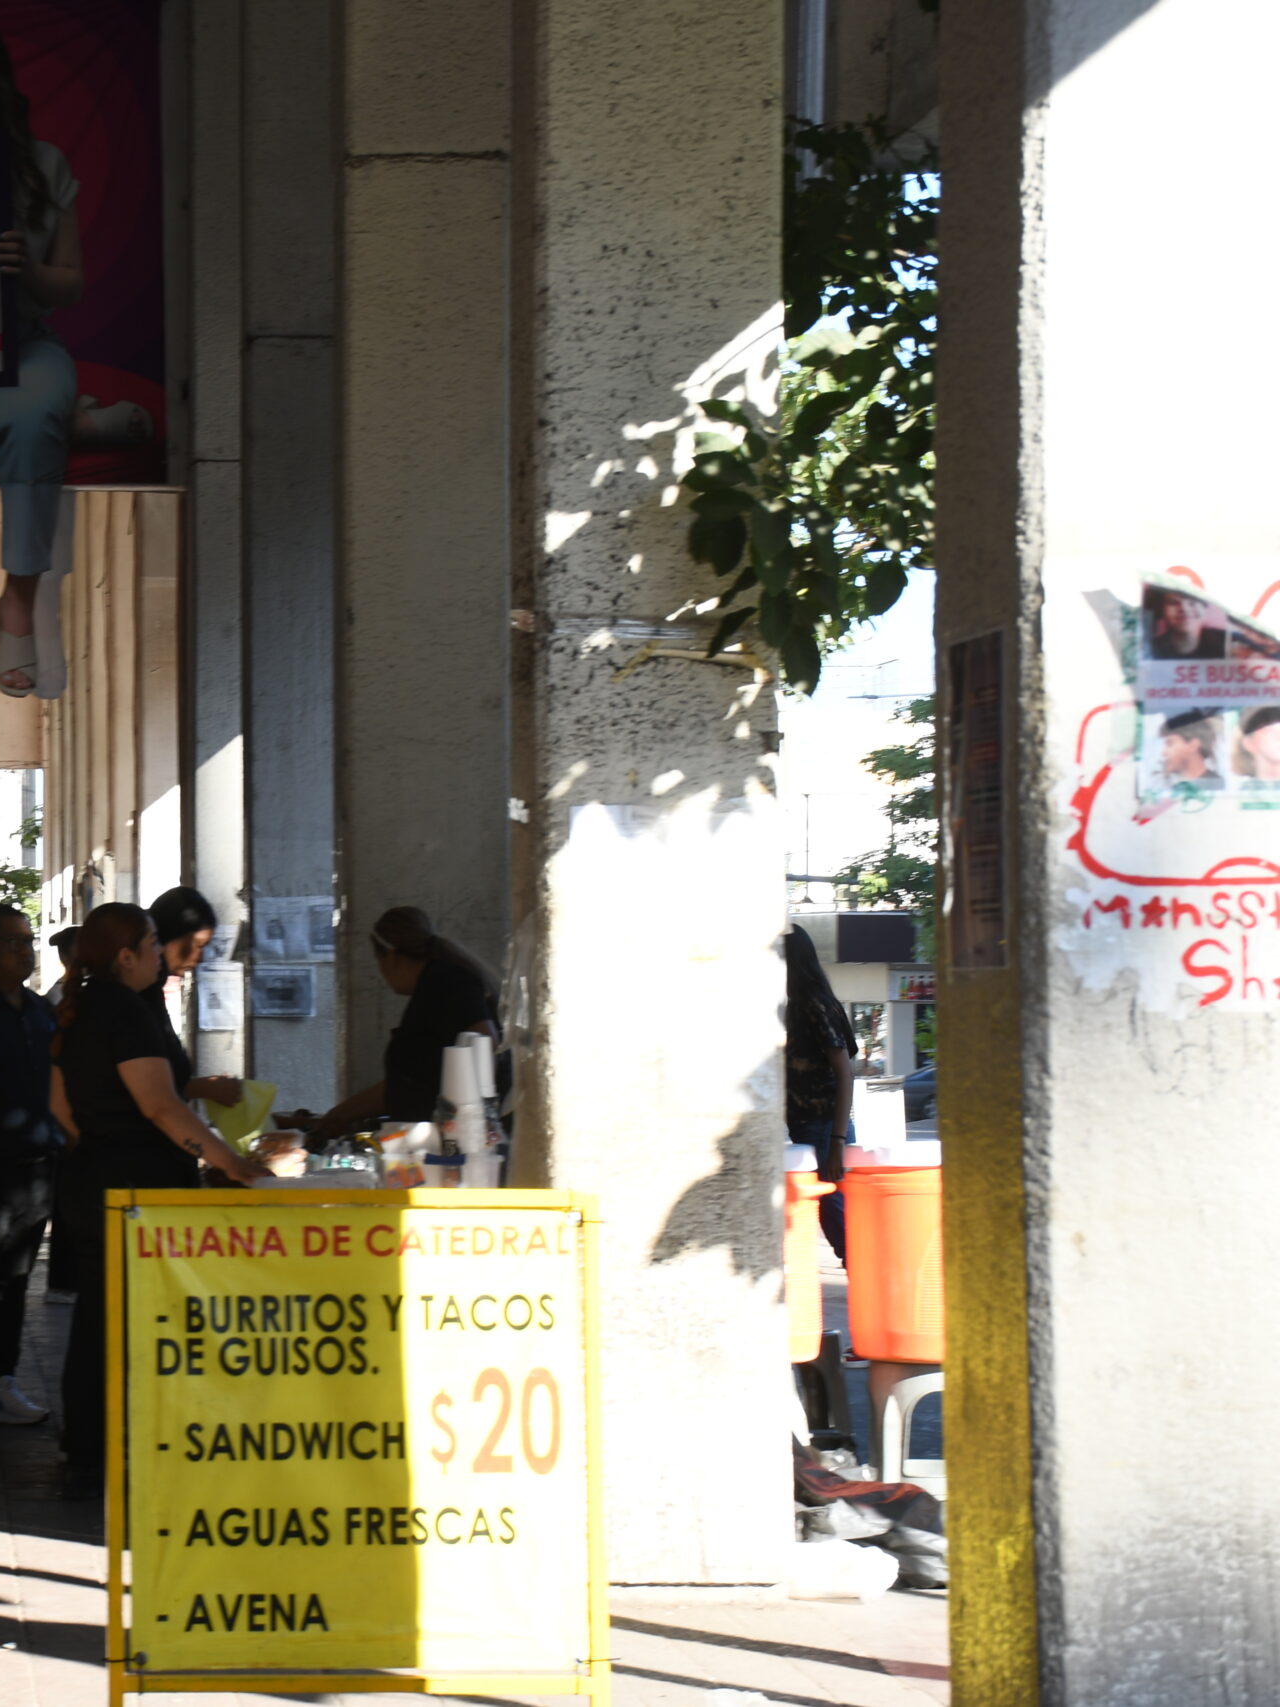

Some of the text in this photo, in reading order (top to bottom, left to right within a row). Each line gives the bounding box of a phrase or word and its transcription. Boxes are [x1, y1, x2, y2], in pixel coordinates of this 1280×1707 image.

[1174, 665, 1198, 683] SE
[136, 1224, 570, 1258] LILIANA DE CATEDRAL
[185, 1294, 367, 1333] BURRITOS
[382, 1295, 404, 1332] Y
[420, 1294, 555, 1332] TACOS
[157, 1337, 380, 1376] DE GUISOS.
[431, 1366, 562, 1475] $20
[185, 1421, 406, 1461] SANDWICH
[185, 1508, 329, 1547] AGUAS
[345, 1507, 516, 1545] FRESCAS
[184, 1594, 330, 1632] AVENA
